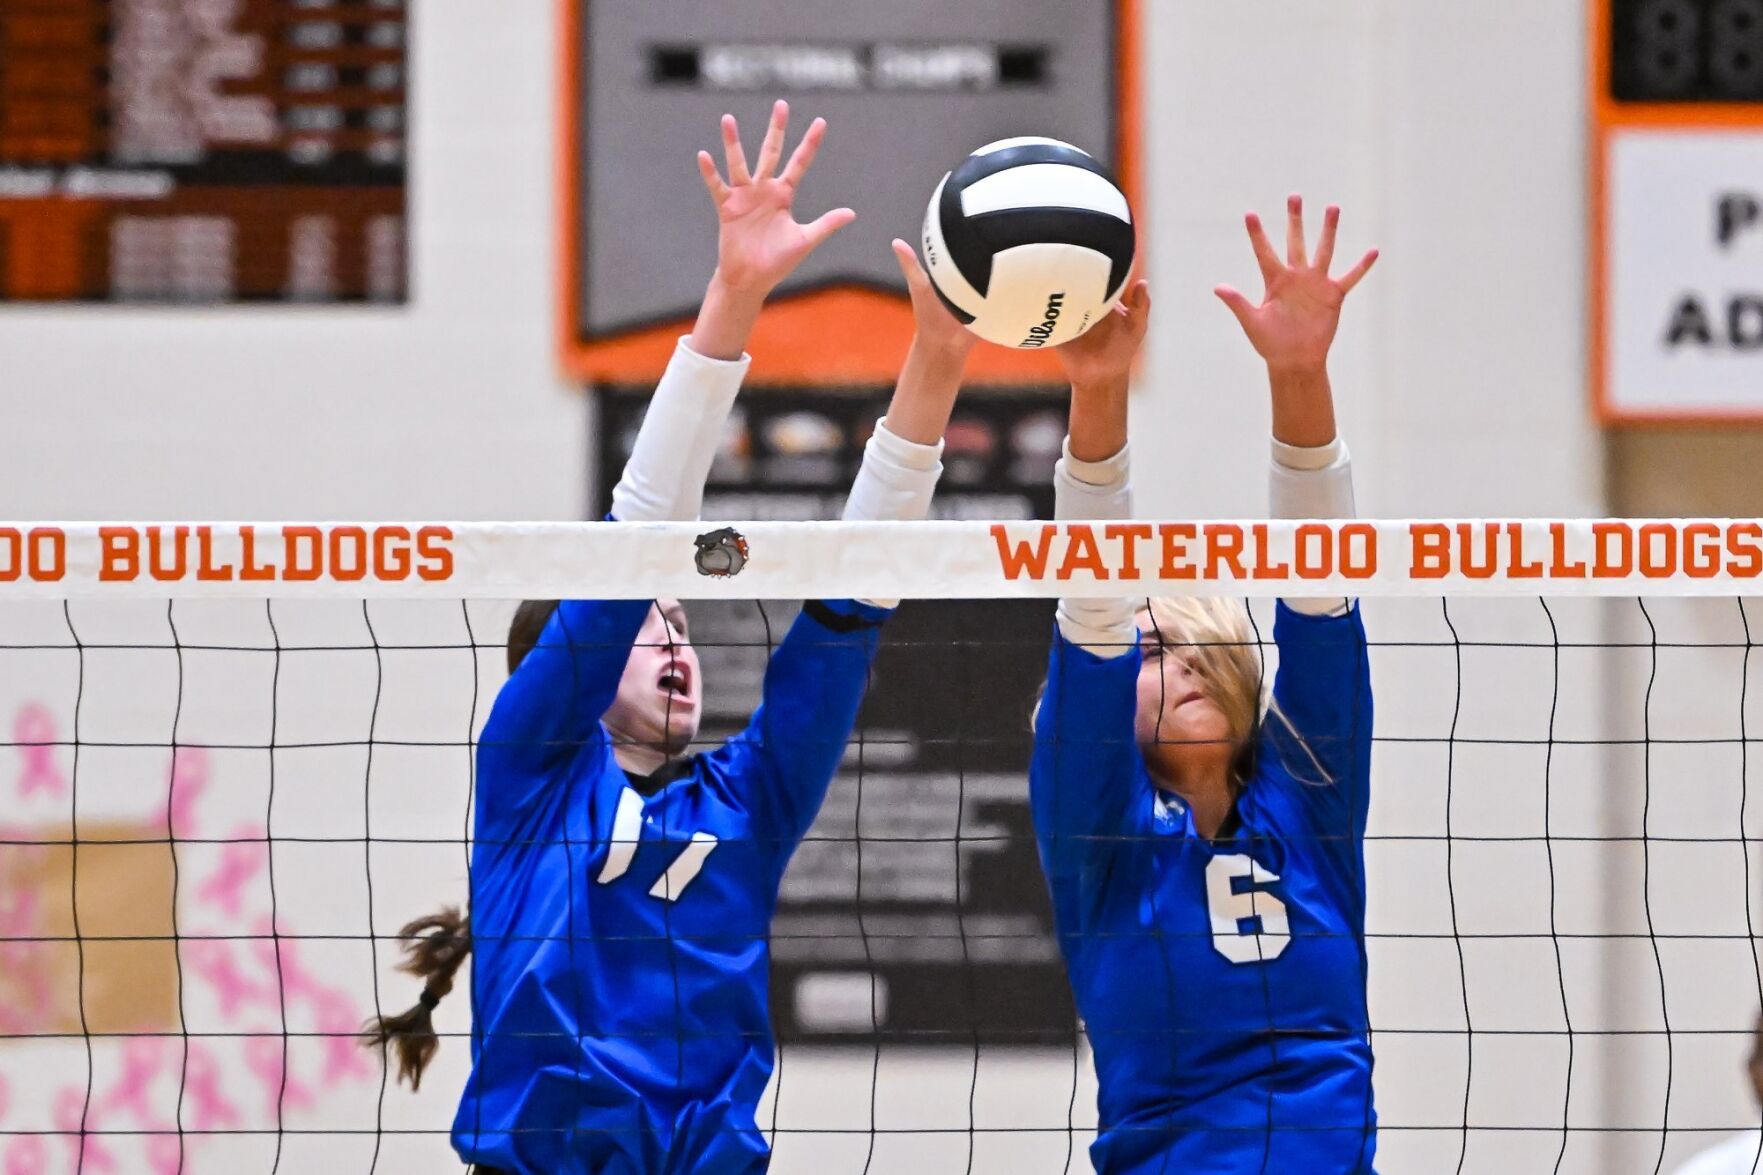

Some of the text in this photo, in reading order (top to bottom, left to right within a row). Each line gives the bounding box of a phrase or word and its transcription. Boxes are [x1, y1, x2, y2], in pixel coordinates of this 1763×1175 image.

[1018, 292, 1066, 347] Wilson
[98, 526, 454, 581] BULLDOGS
[990, 523, 1763, 580] WATERLOO BULLDOGS
[1205, 853, 1292, 964] 6
